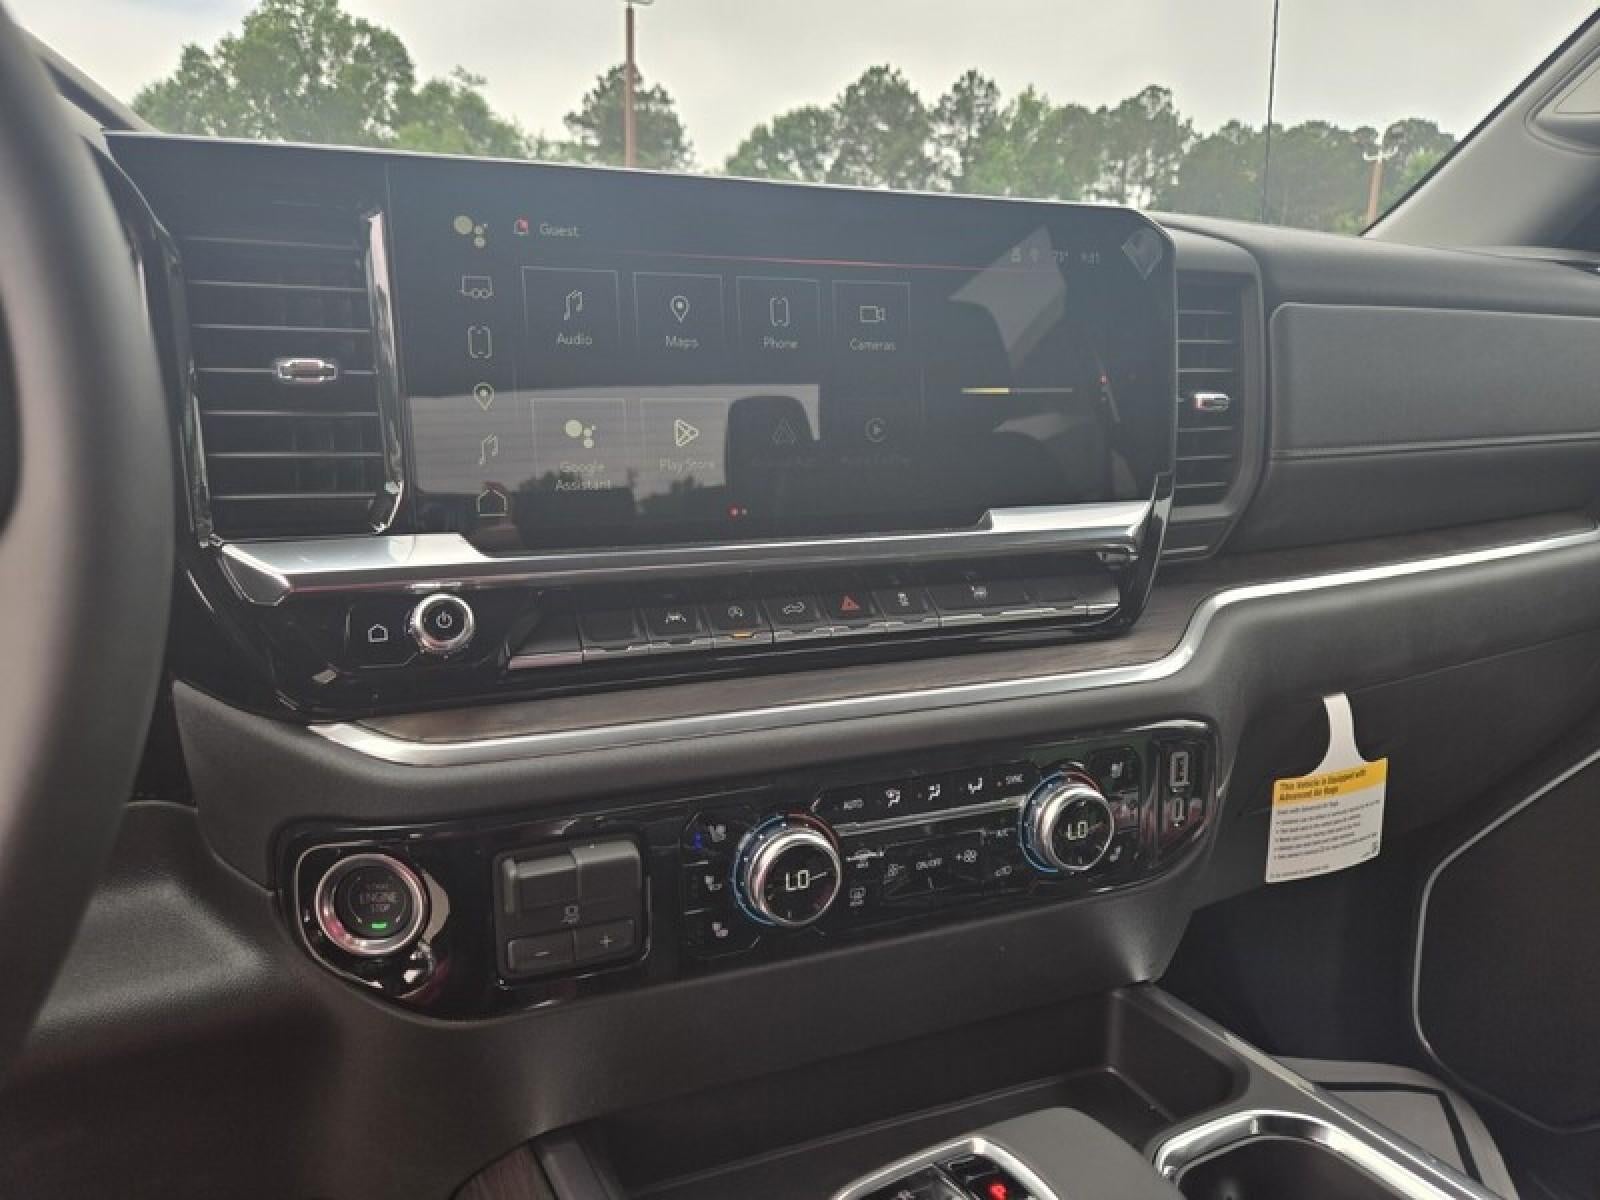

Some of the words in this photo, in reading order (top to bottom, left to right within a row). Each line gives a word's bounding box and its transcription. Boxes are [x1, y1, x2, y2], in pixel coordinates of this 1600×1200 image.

[539, 223, 580, 238] Guest
[556, 332, 593, 346] Audio
[665, 335, 699, 350] Maps
[763, 336, 799, 350] Phone
[849, 338, 897, 352] Cameras
[560, 459, 606, 476] Google
[659, 457, 684, 472] Play
